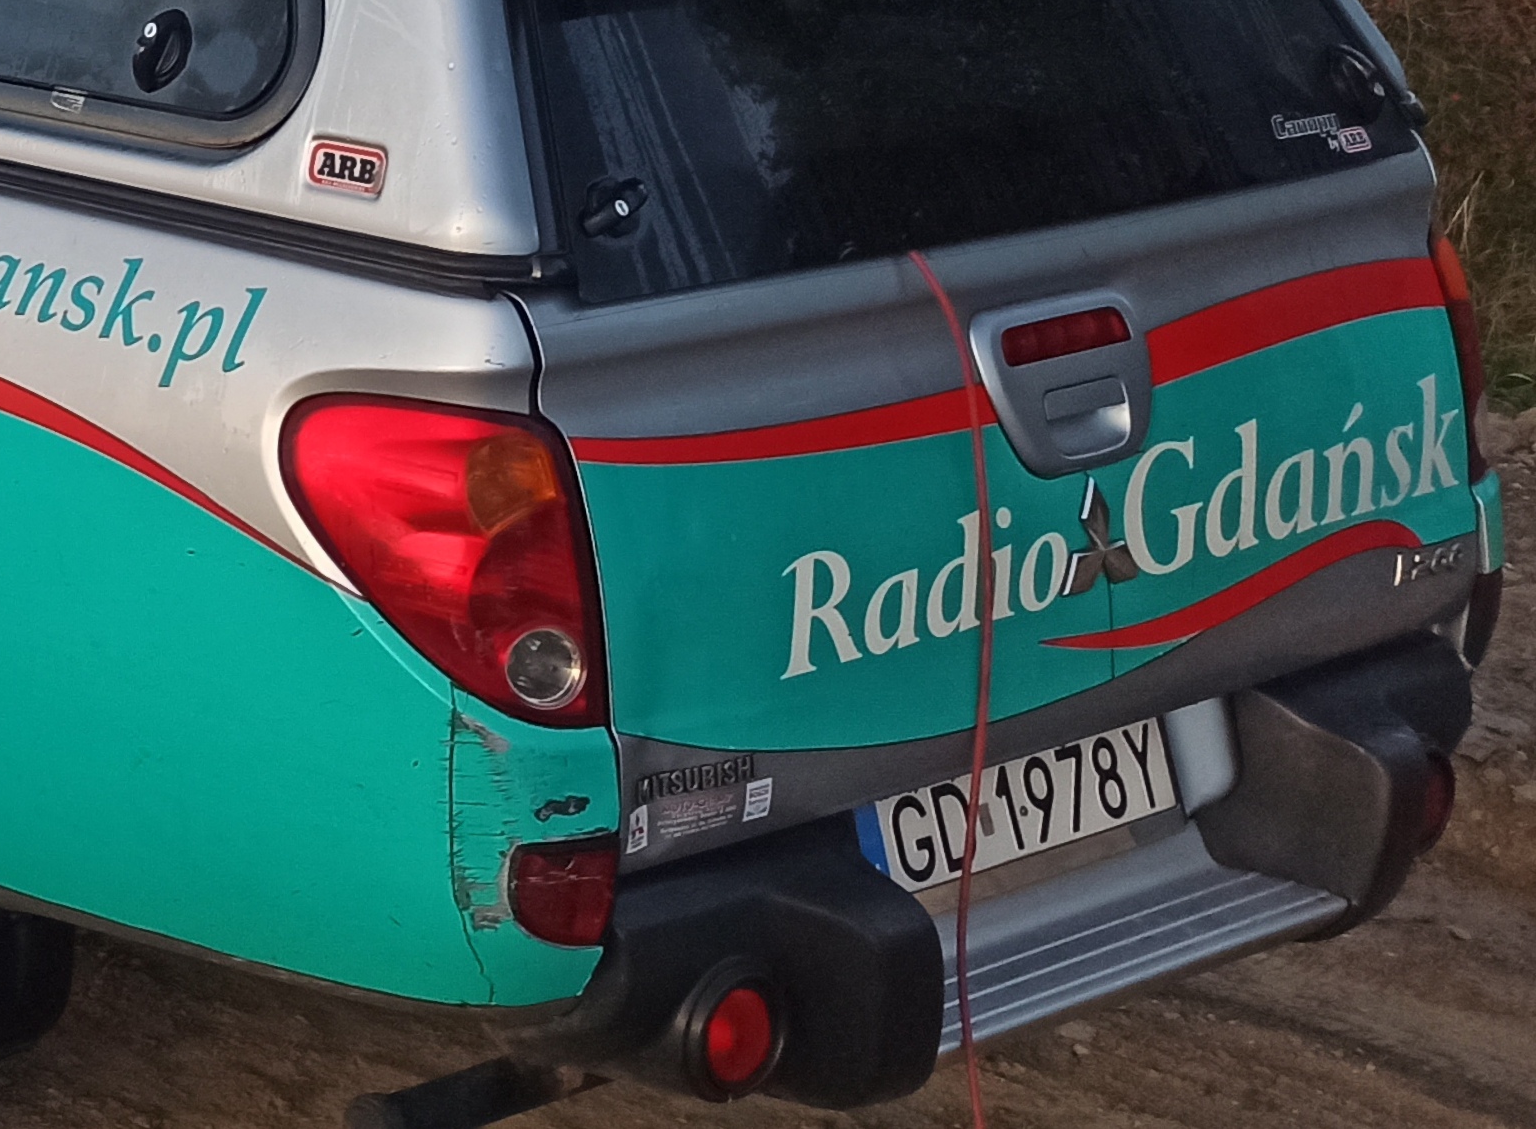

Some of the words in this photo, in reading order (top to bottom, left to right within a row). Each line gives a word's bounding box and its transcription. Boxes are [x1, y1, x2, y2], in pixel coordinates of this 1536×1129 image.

[316, 151, 376, 185] ARB
[779, 507, 1070, 680] Radio
[1124, 373, 1461, 576] Gdańsk
[890, 782, 976, 883] GD
[994, 722, 1157, 851] 1978Y
